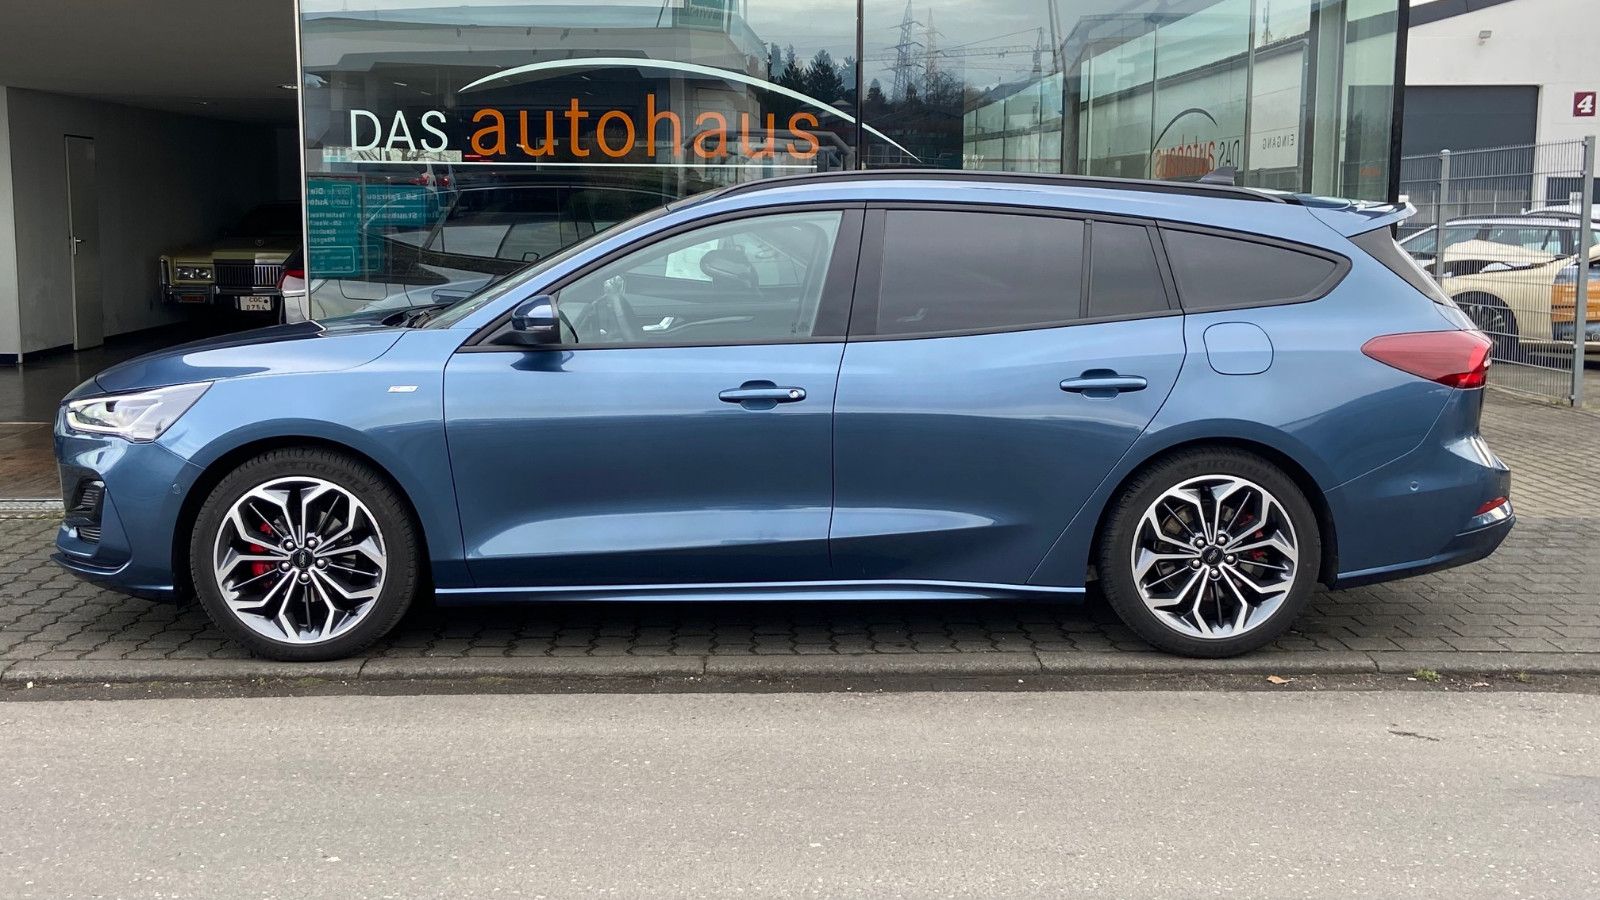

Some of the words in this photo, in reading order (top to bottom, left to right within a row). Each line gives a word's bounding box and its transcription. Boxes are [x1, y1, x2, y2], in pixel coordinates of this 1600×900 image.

[1577, 95, 1593, 113] 4
[349, 109, 448, 153] DAS
[470, 93, 820, 159] autohaus
